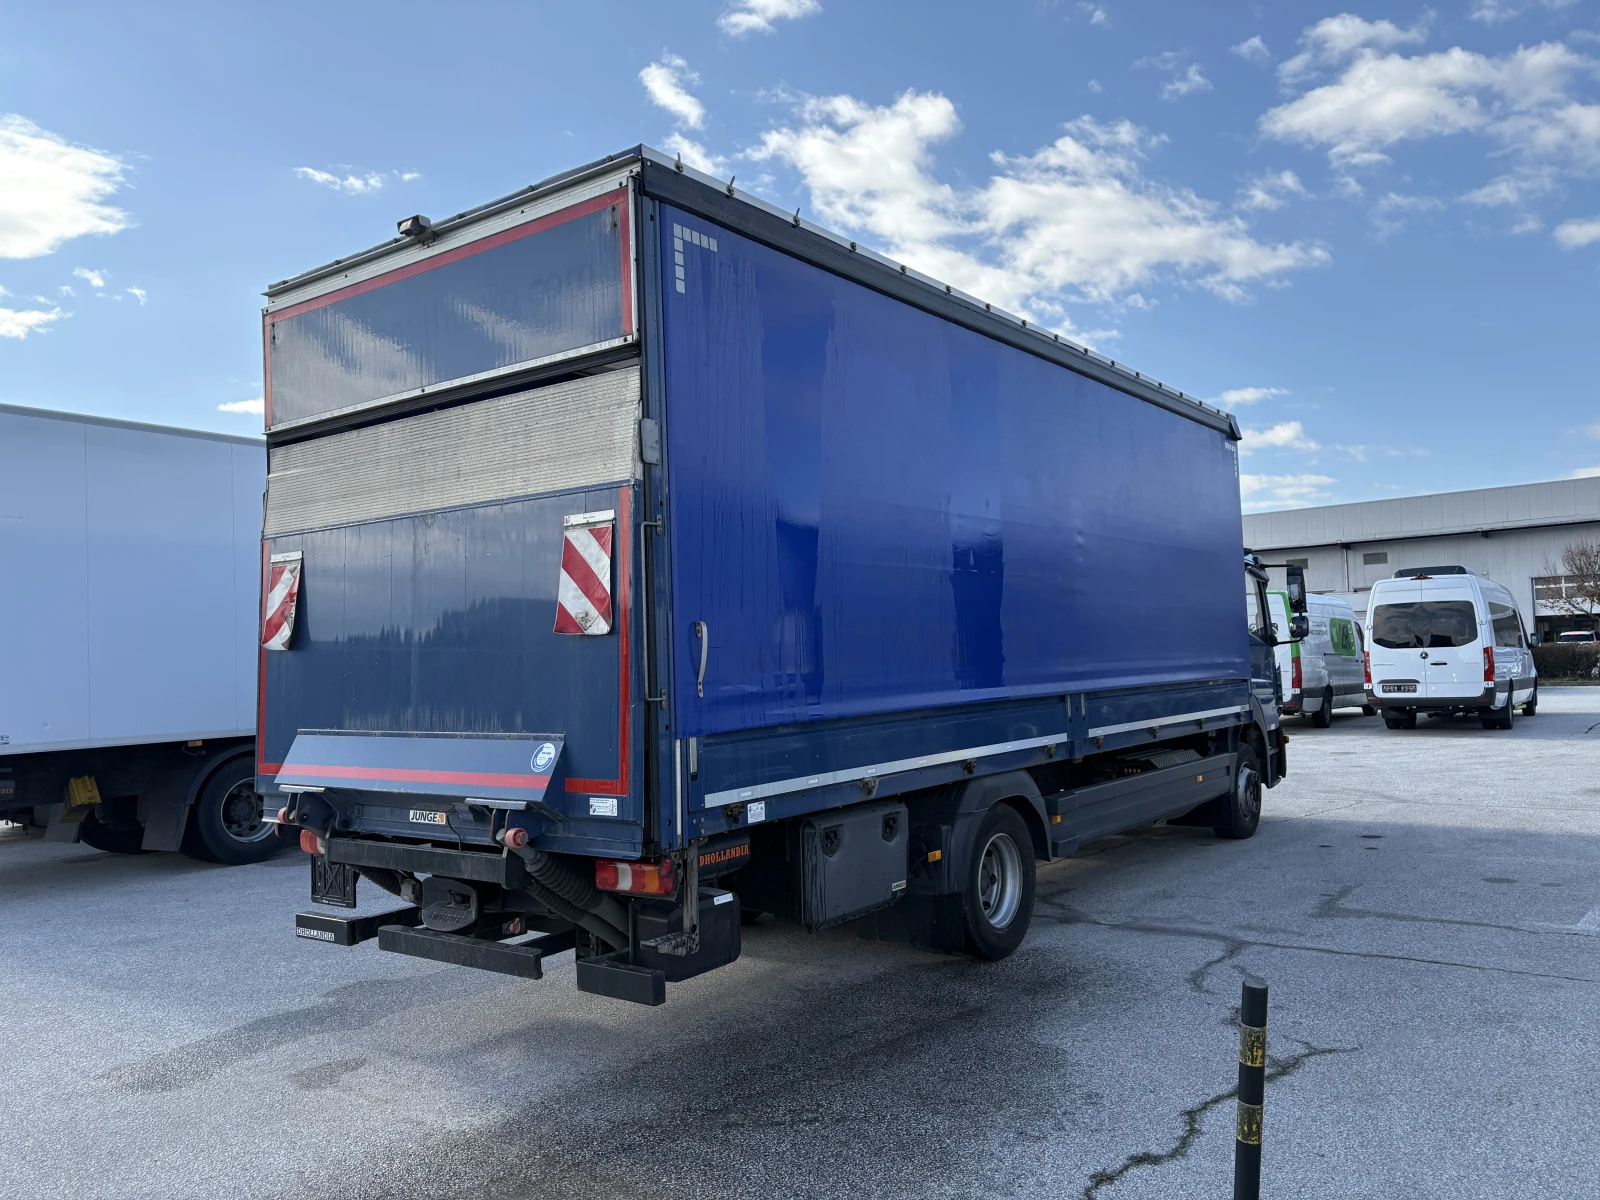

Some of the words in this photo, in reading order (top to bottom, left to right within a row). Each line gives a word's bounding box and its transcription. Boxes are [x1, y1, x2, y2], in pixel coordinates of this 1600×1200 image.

[411, 810, 438, 823] JUNGE
[699, 844, 749, 867] DHOLLANDIA
[297, 927, 334, 941] DHOLLANDIA
